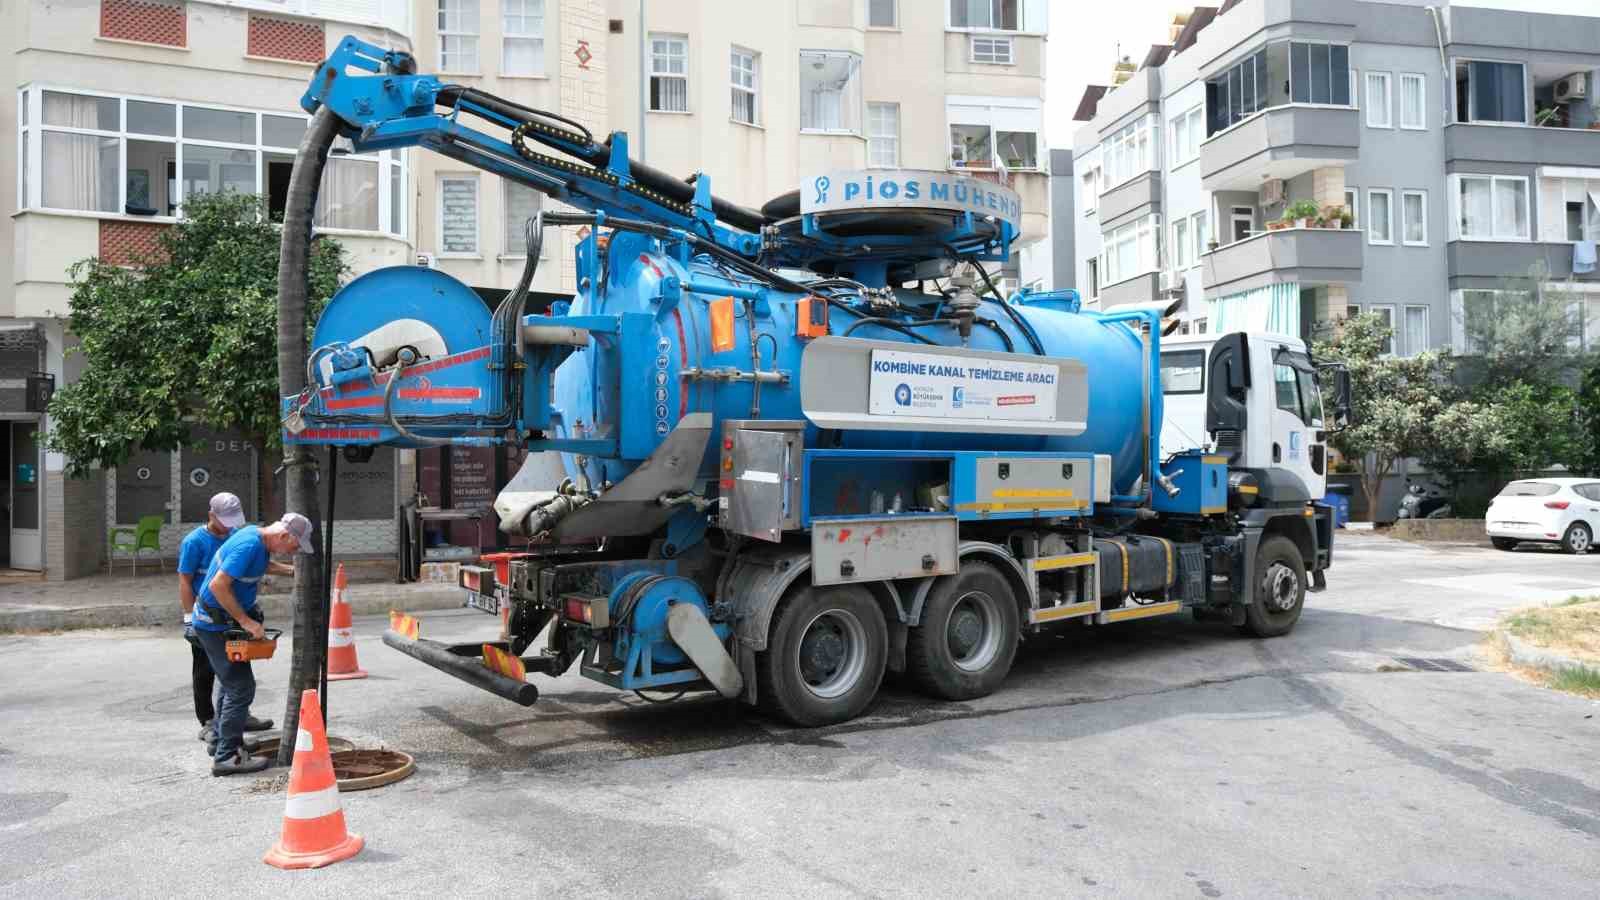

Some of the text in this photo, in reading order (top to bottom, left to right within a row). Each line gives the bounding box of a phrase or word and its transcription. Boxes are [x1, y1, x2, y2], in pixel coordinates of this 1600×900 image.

[873, 360, 1055, 386] KOMBİNE KANAL TEMİZLEME ARACI
